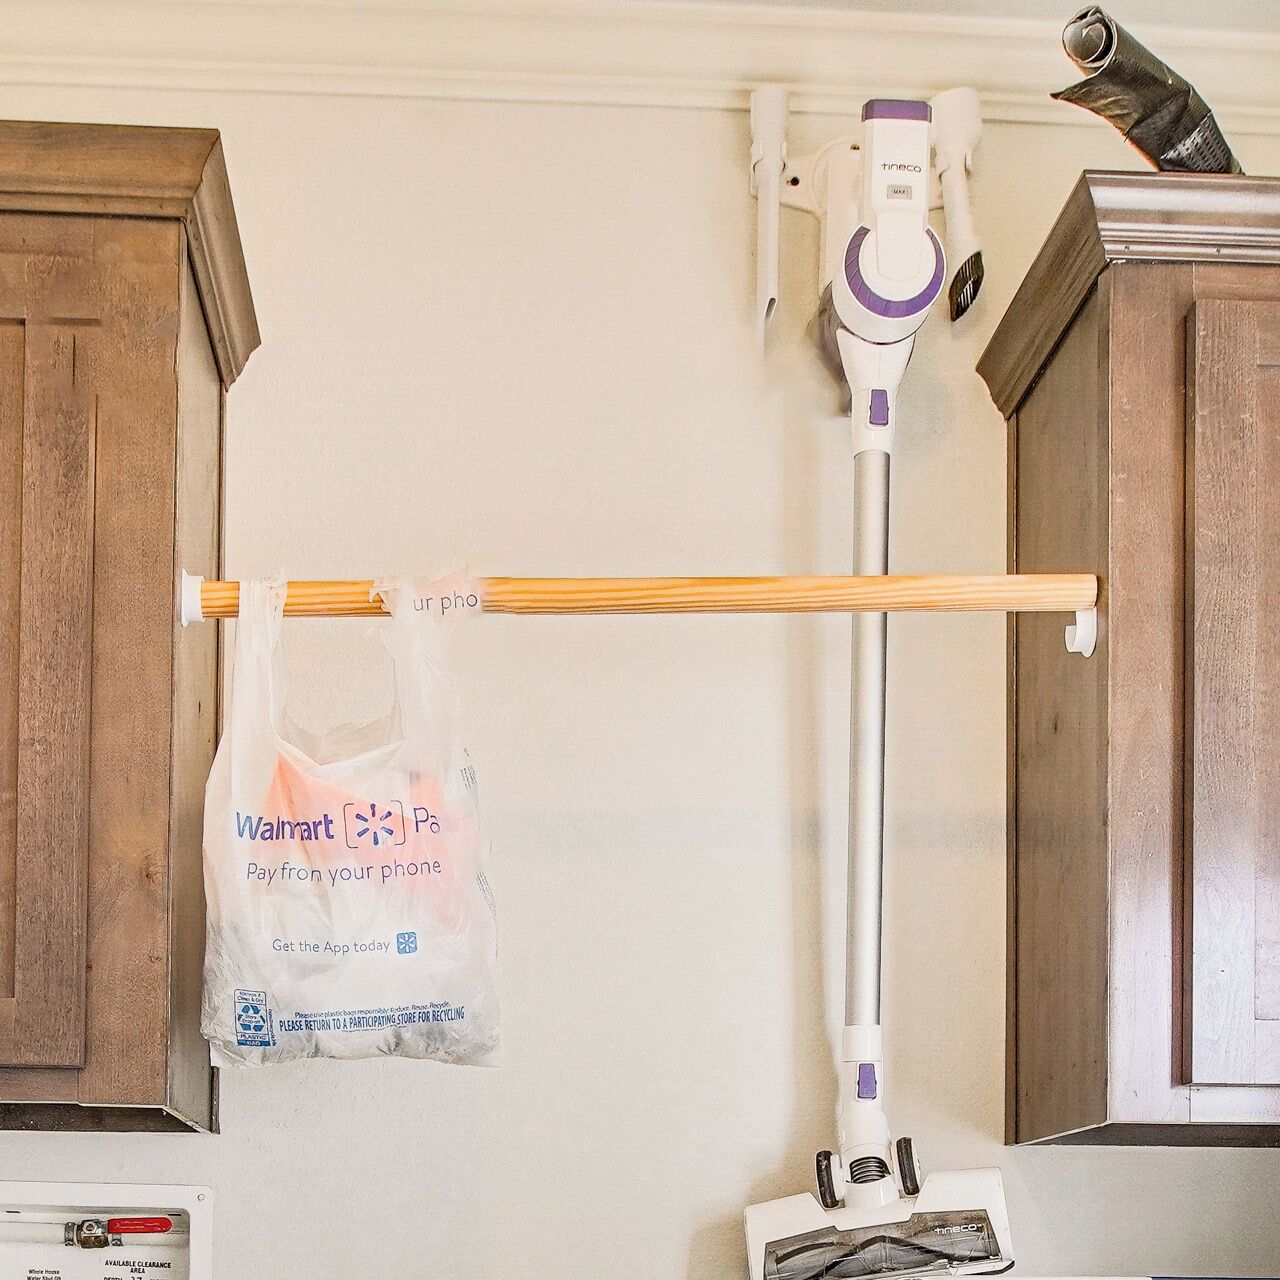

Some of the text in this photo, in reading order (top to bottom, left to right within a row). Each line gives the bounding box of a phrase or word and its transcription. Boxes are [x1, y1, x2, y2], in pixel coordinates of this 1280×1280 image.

[881, 163, 921, 173] tineco
[440, 590, 478, 615] pho
[236, 811, 334, 841] Walmart
[247, 862, 277, 886] Pay
[328, 866, 373, 887] your
[381, 859, 442, 884] phone
[272, 938, 390, 956] Get the App today
[280, 1020, 303, 1031] PLEASE
[305, 1019, 331, 1031] RETURN
[332, 1018, 340, 1030] TO
[342, 1017, 348, 1029] A
[349, 1014, 396, 1029] PARTICIPATING
[397, 1011, 416, 1025] STORE
[418, 1010, 431, 1023] FOR
[432, 1006, 465, 1022] RECYCLING
[295, 1011, 313, 1019] Please
[324, 1010, 343, 1018] plastic
[343, 1009, 357, 1018] bags
[934, 1224, 977, 1234] tineco
